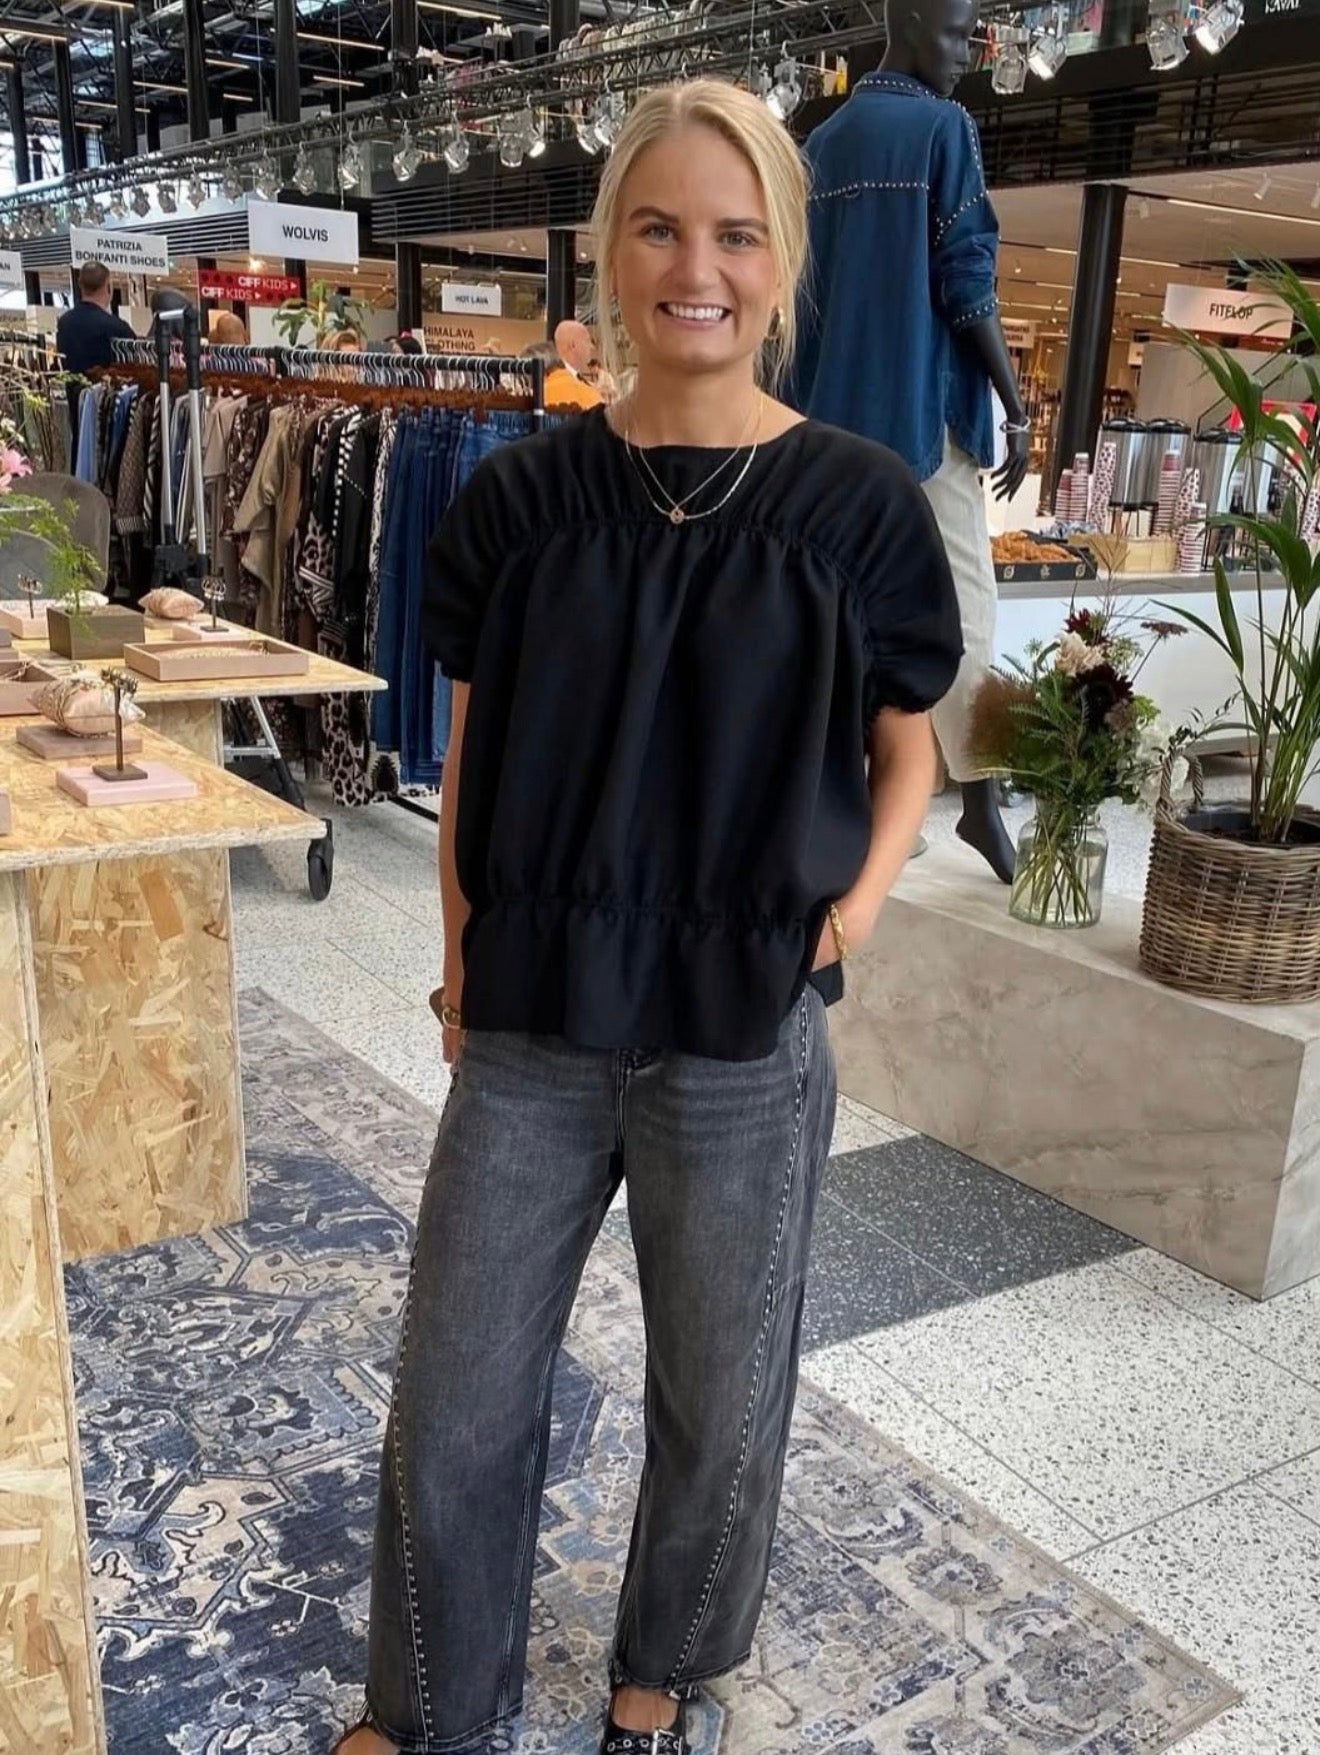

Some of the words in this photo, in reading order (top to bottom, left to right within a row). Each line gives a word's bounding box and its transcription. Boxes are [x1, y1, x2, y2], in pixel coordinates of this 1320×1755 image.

[282, 224, 329, 242] WOLVIS
[97, 238, 142, 251] PATRIZIA
[75, 250, 128, 264] BONFANTI
[130, 255, 165, 267] SHOES
[262, 279, 288, 290] KIDS
[226, 288, 253, 300] KIDS
[424, 326, 475, 338] HIMALAYA
